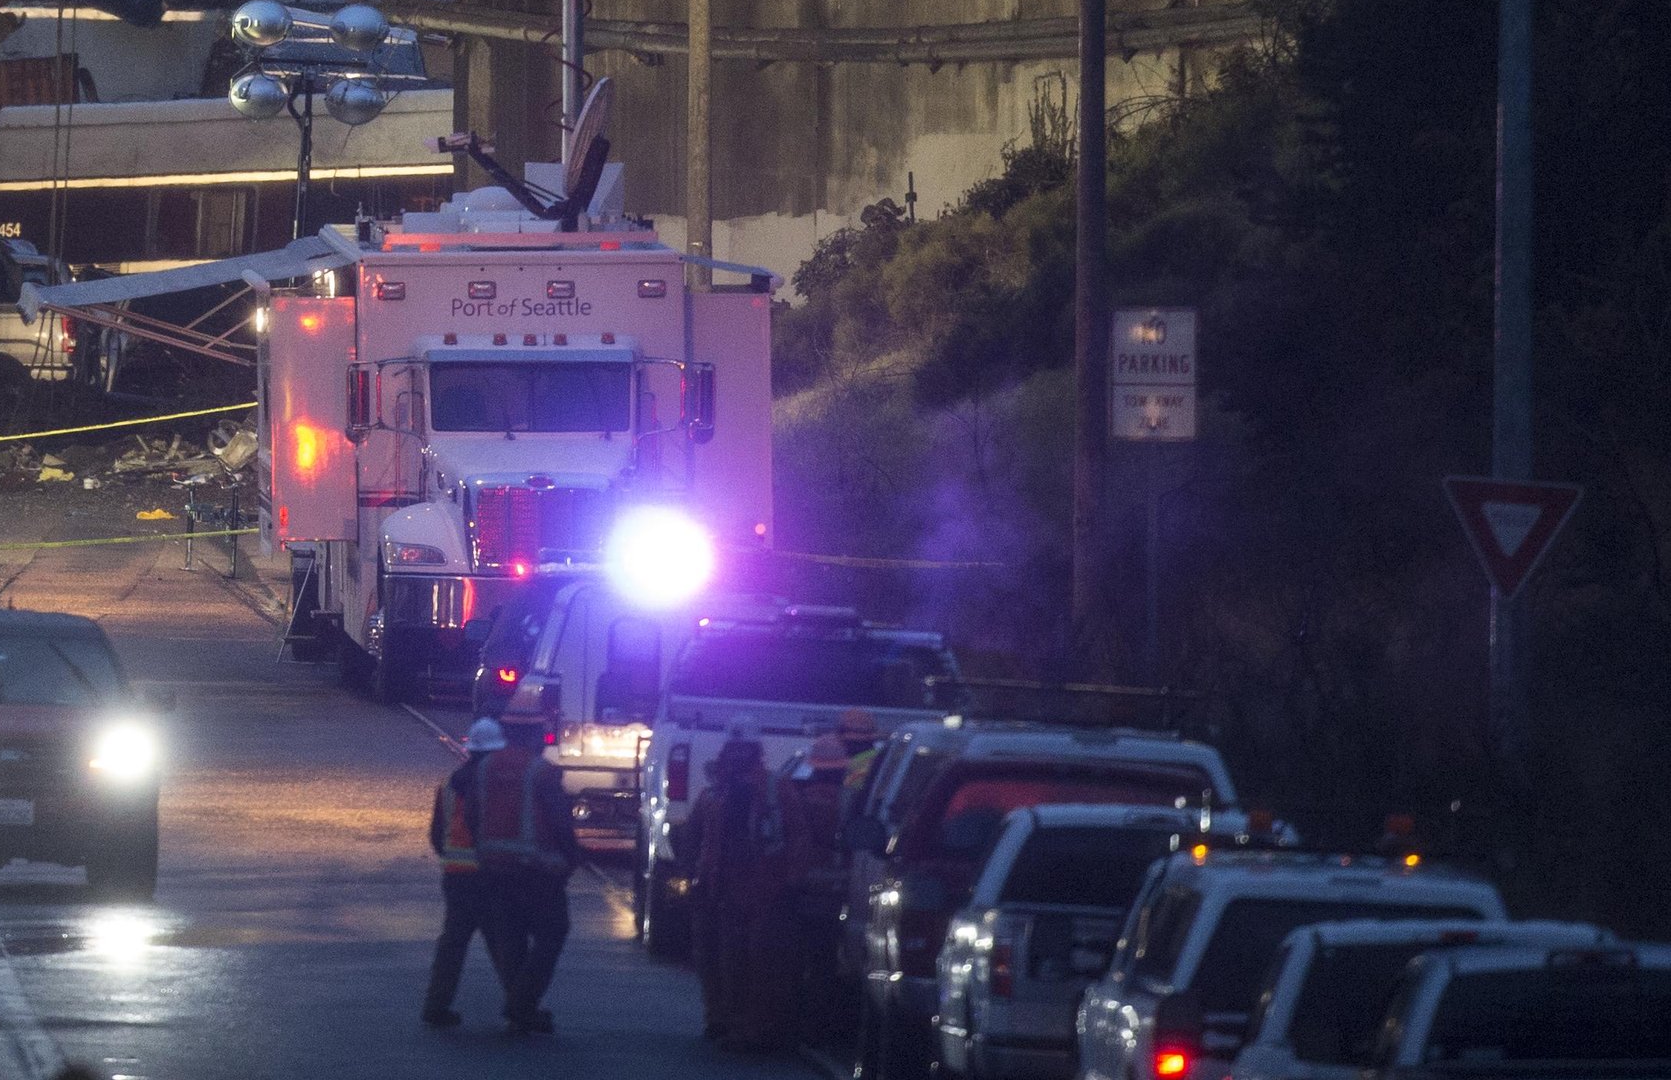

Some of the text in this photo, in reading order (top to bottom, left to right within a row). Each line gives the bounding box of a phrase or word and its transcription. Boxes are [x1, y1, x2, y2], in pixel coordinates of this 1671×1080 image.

[451, 297, 592, 317] Port of Seattle
[1118, 353, 1190, 374] PARKING
